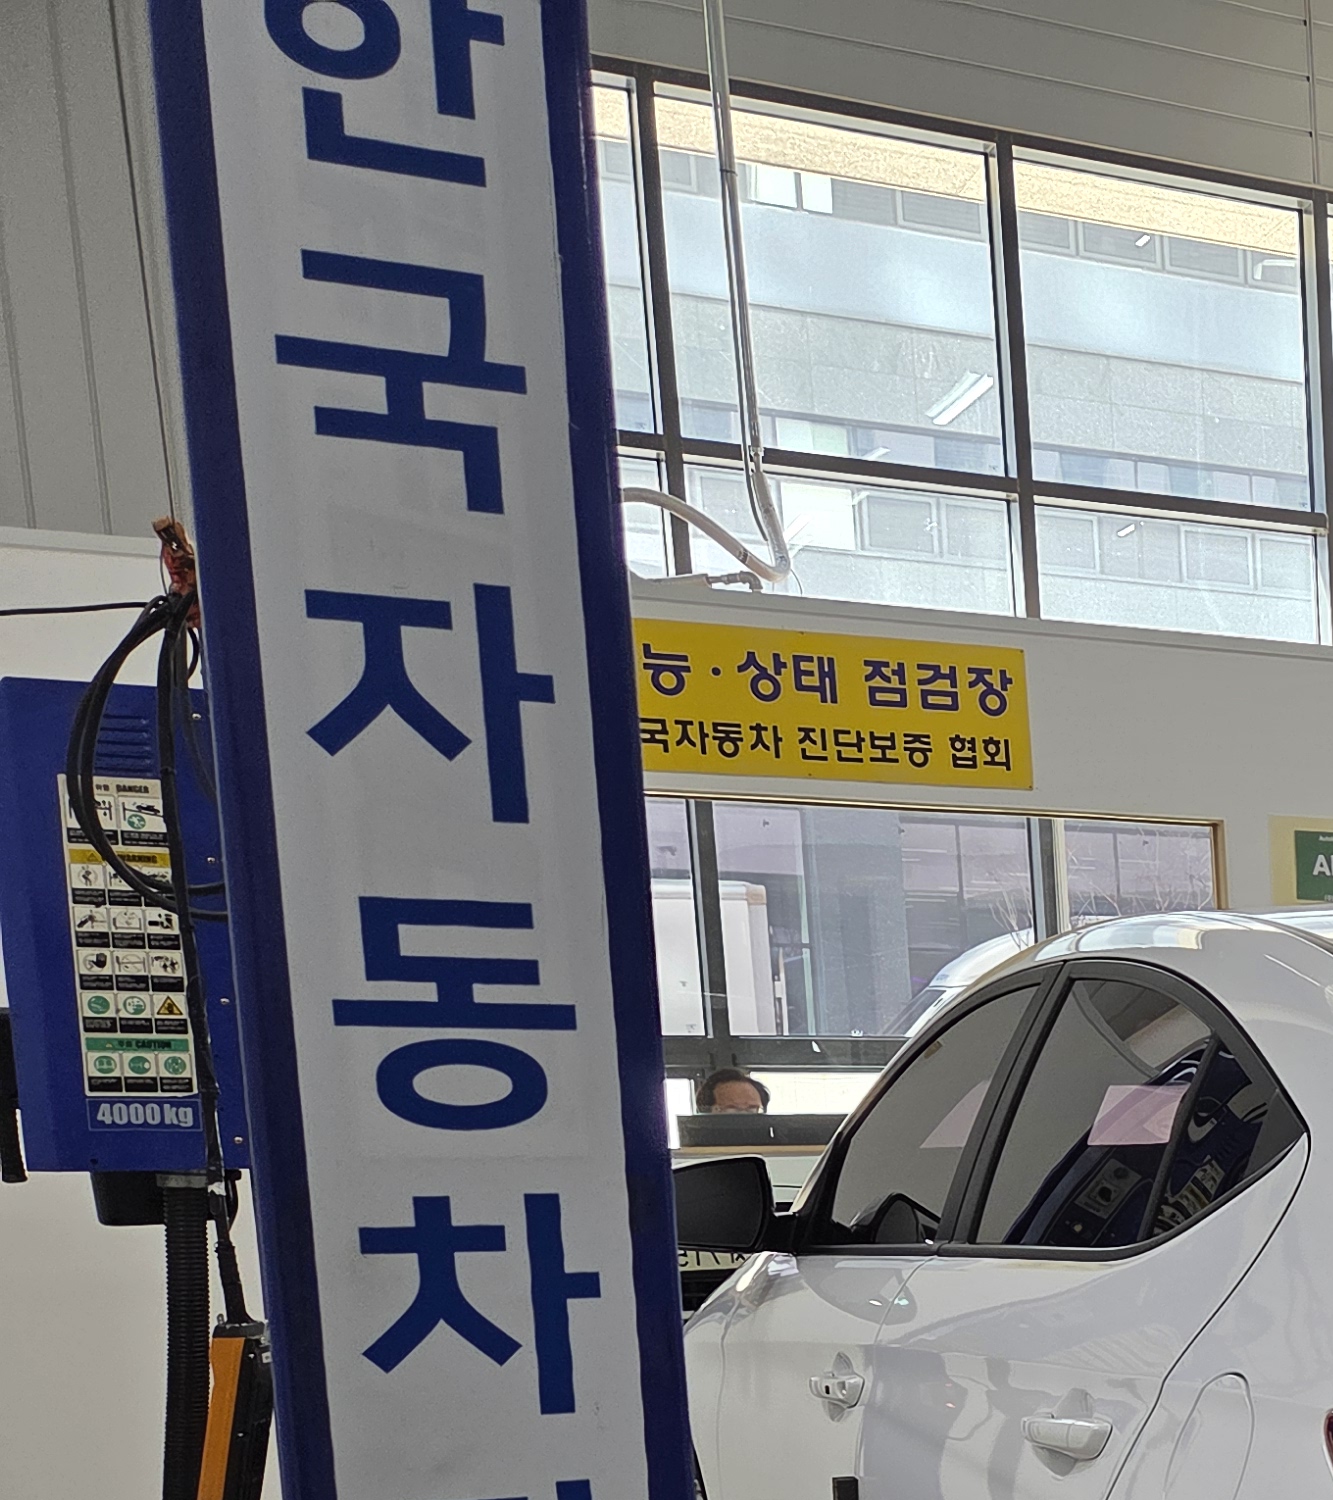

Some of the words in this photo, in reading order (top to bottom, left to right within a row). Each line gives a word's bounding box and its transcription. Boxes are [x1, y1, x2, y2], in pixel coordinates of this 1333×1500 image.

[863, 659, 1013, 717] 점검장
[638, 717, 783, 759] 국자동차
[797, 726, 933, 768] 진단보증
[948, 733, 1012, 772] 협회
